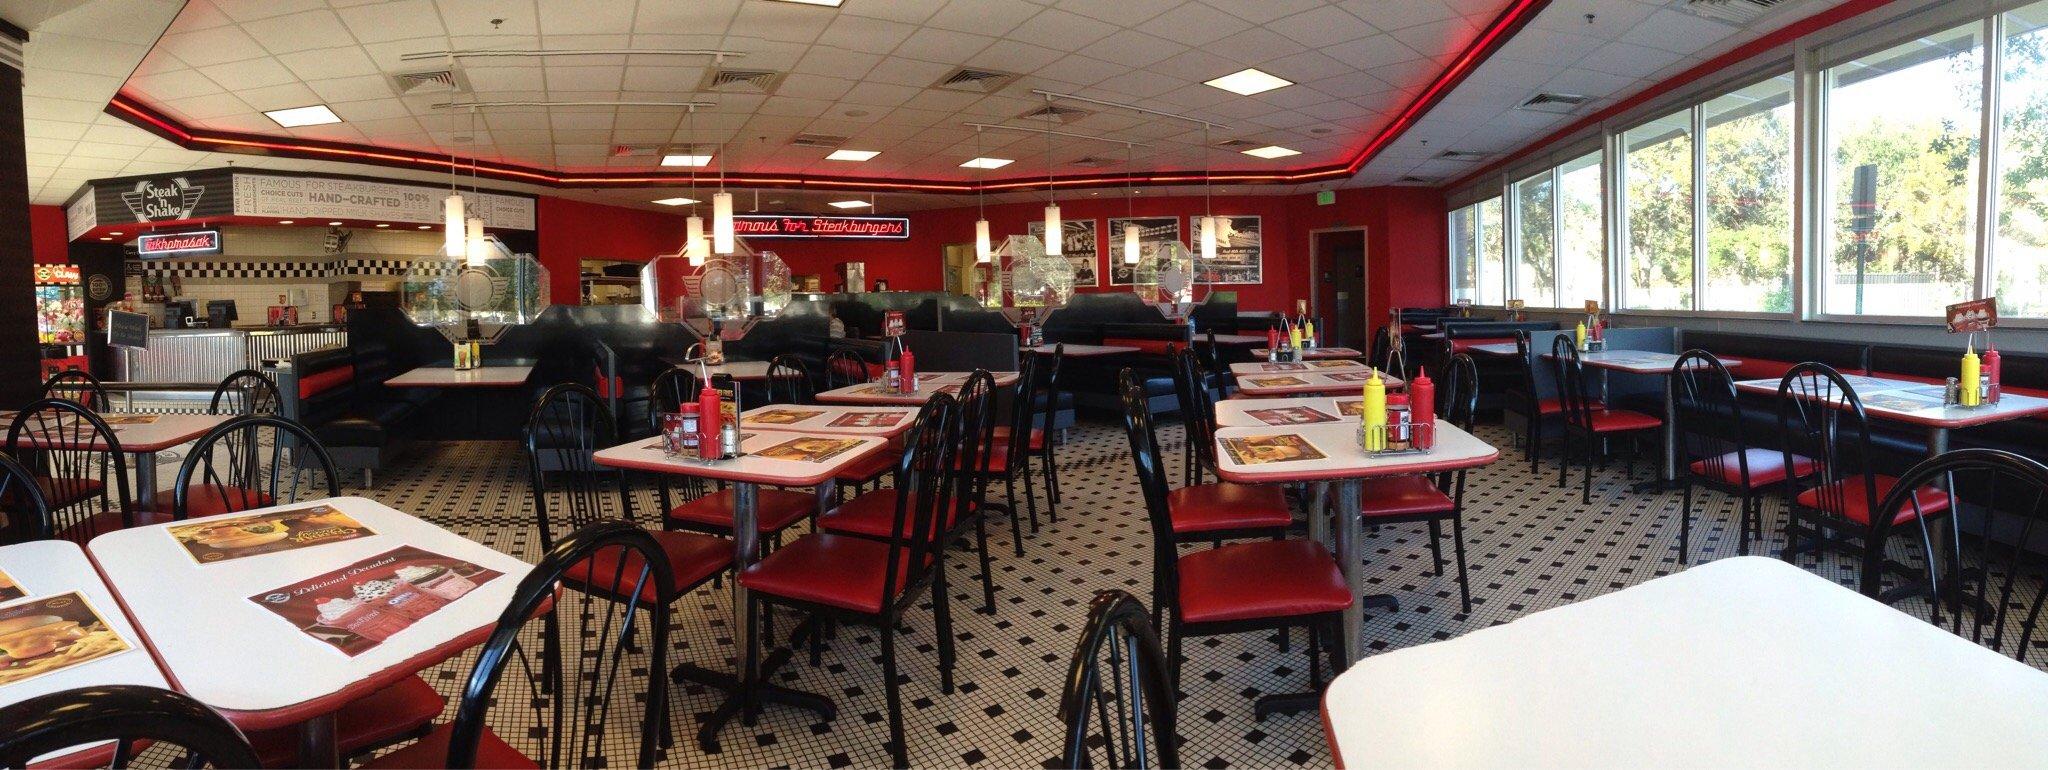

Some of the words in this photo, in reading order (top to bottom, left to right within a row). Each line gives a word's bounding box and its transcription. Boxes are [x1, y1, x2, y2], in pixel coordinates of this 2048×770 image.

[146, 183, 179, 198] Steak
[260, 179, 301, 189] FAMOUS
[305, 181, 325, 190] FOR
[328, 182, 400, 195] STEAKBURGERS
[309, 192, 401, 207] HAND-CRAFTED
[403, 192, 430, 202] 100%
[146, 203, 181, 218] Shake
[732, 219, 779, 232] amous
[811, 219, 903, 236] Steakburgers
[348, 556, 397, 576] Decadent
